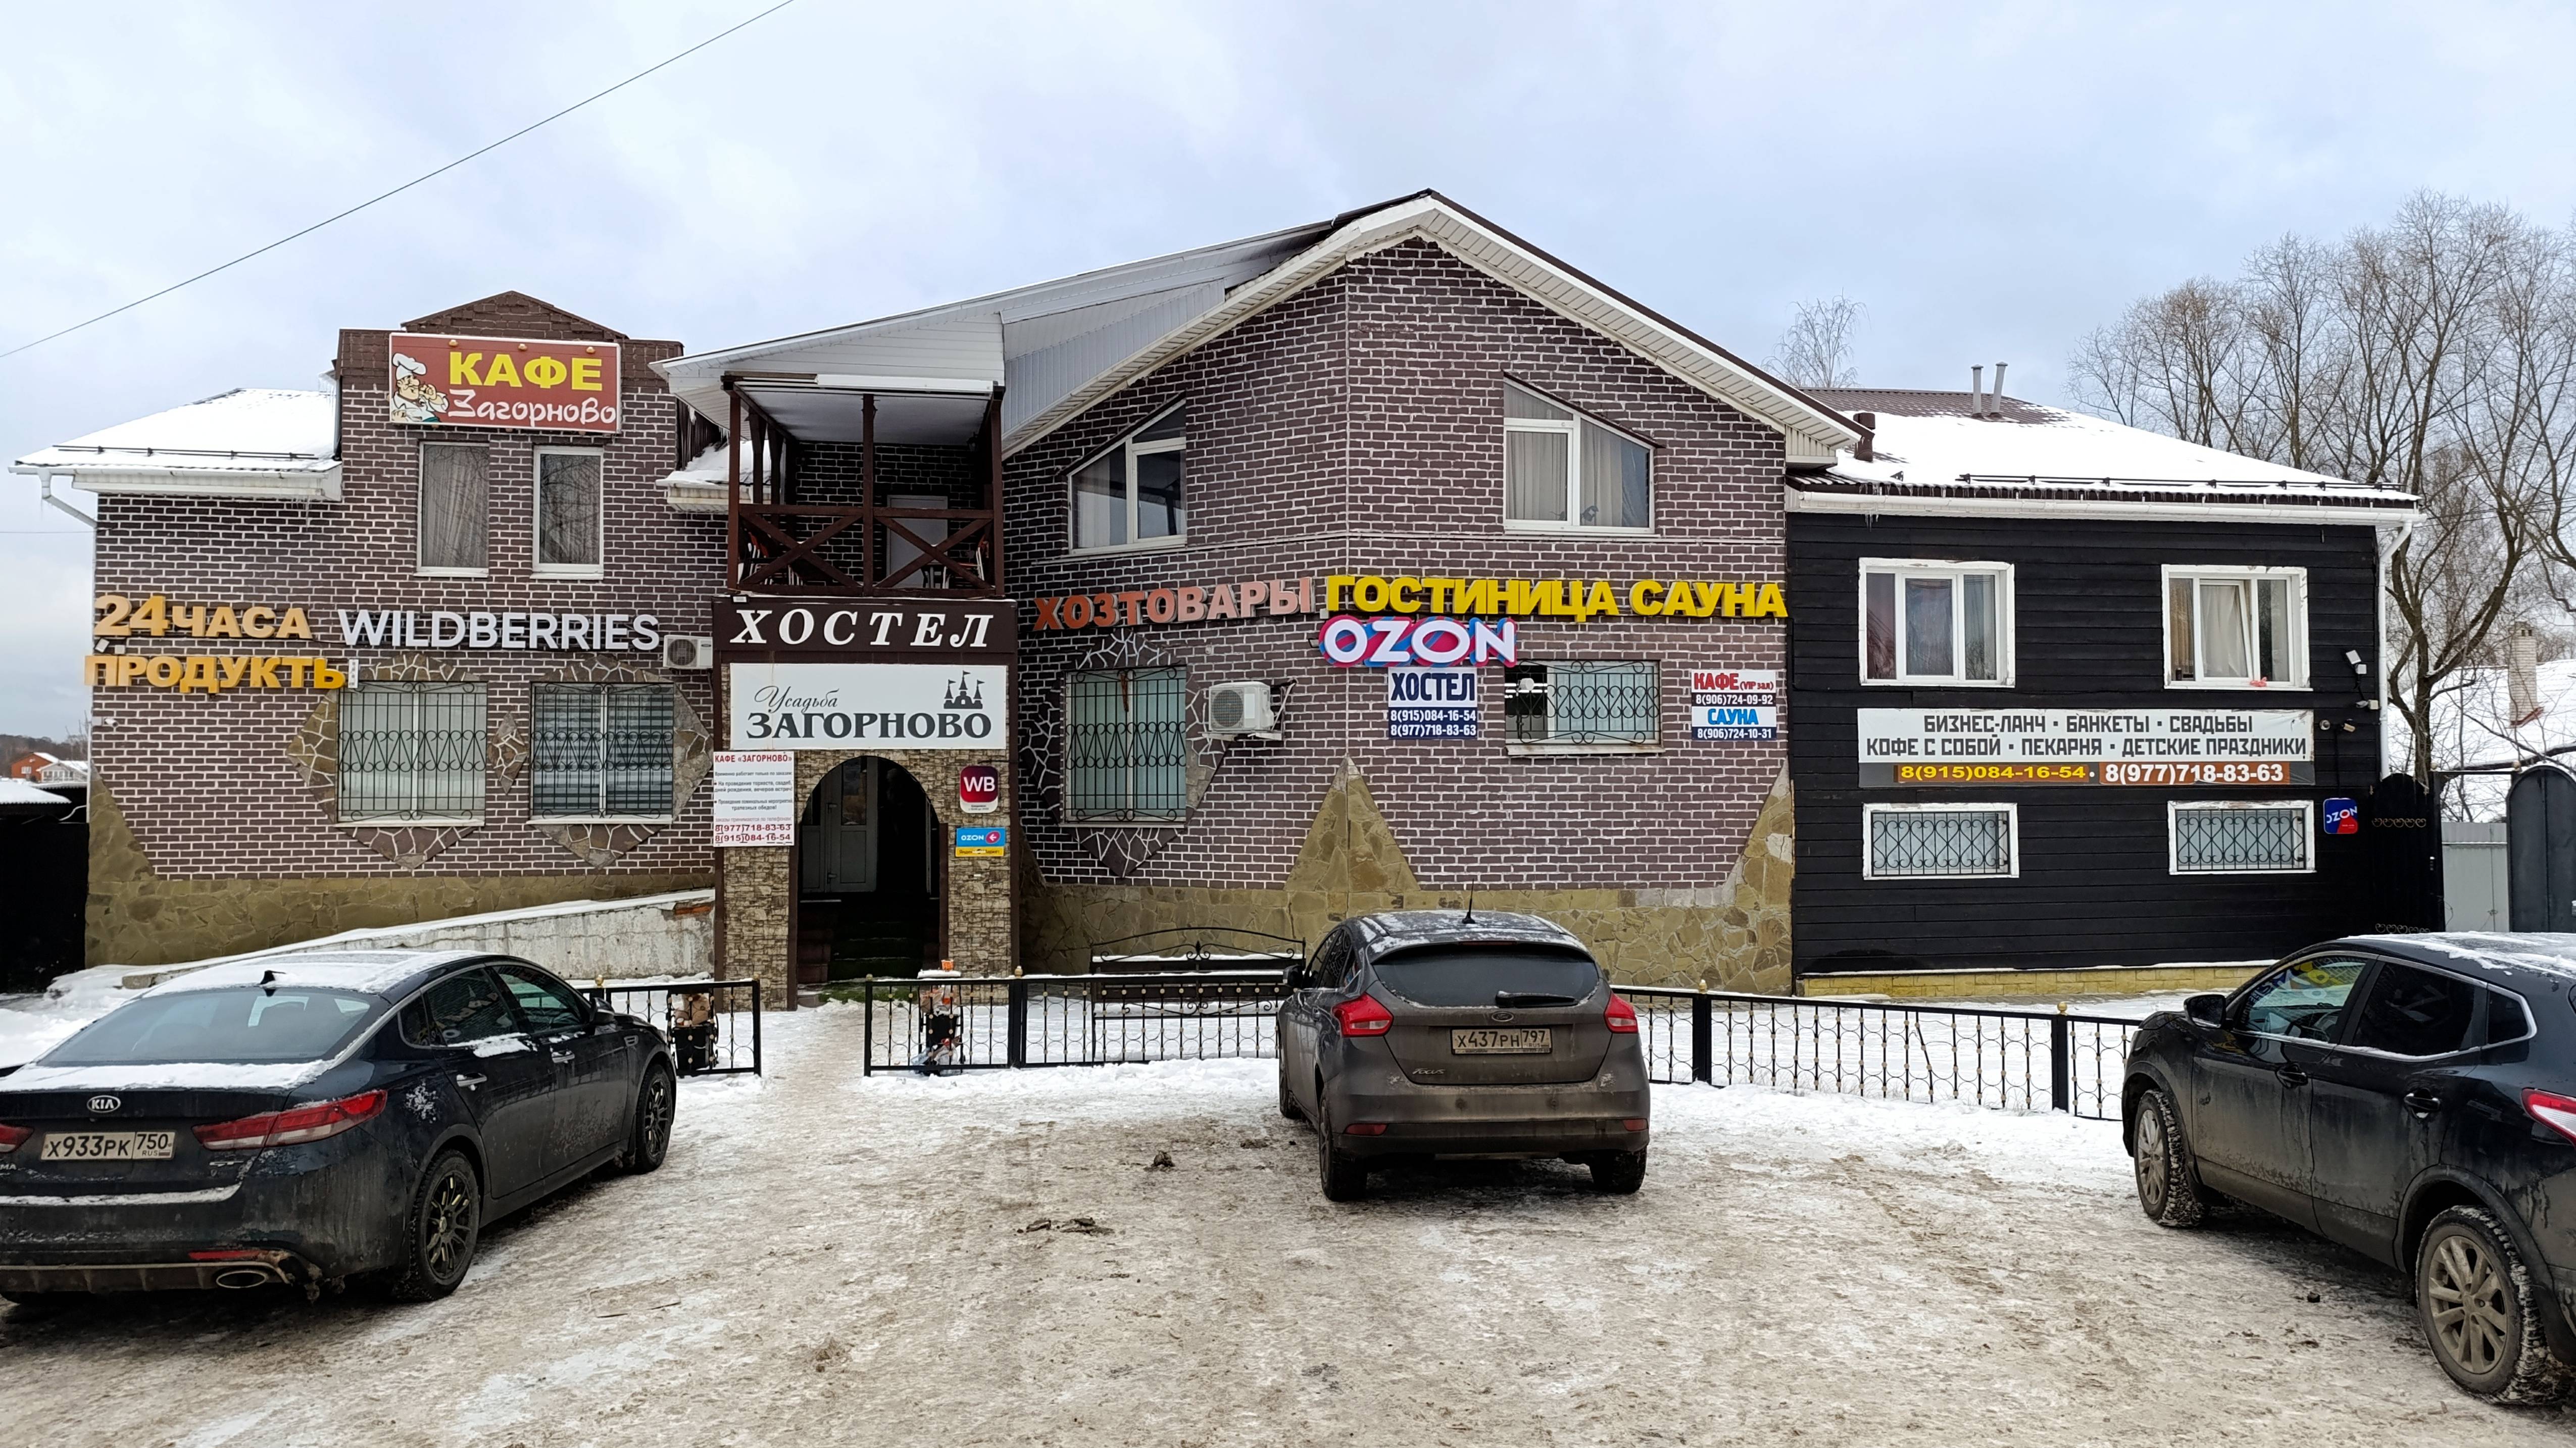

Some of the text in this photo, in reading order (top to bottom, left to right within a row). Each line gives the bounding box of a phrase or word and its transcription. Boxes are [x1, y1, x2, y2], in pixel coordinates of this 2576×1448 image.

[450, 352, 602, 391] КАФЕ
[448, 389, 616, 427] Загорново
[1033, 577, 1314, 631] ХОЗТОВАРЫ
[1326, 575, 1788, 622] ГОСТИНИЦА САУНА
[338, 609, 659, 651] WILDBERRIES
[730, 609, 994, 647] ХОСТЕЛ
[1324, 619, 1515, 663] OZON
[1391, 672, 1475, 702] ХОСТЕЛ
[1694, 673, 1774, 690] КАФЕ (VIP зал)
[754, 685, 840, 713] Усадьба
[1696, 694, 1773, 705] 8(906)724-09-92
[746, 712, 992, 738] ЗАГОРНОВО
[1391, 710, 1476, 722] 8(915)084-16-54
[1708, 708, 1759, 725] САУНА
[1924, 715, 2252, 734] БИЗНЕС-ЛАНЧ БАНКЕТЫ СВАДЬБЫ
[1391, 724, 1476, 737] 8(977)718-83-63
[1697, 728, 1771, 739] 8(906)724-10-31
[1867, 734, 2306, 757] КОФЕ С СОБОЙ ПЕКАРНЯ ДЕТСКИЕ ПРАЗДНИКИ
[1901, 764, 2284, 784] 8(915)084-16-54 8(977)718-83-63
[963, 776, 995, 792] WB
[2326, 806, 2357, 824] OZON
[715, 824, 791, 832] 8(977)718-83-63
[715, 834, 790, 843] 8(915)084-16-54
[1522, 1030, 1546, 1043] 797
[91, 1099, 115, 1109] KIA
[136, 1134, 169, 1150] 750
